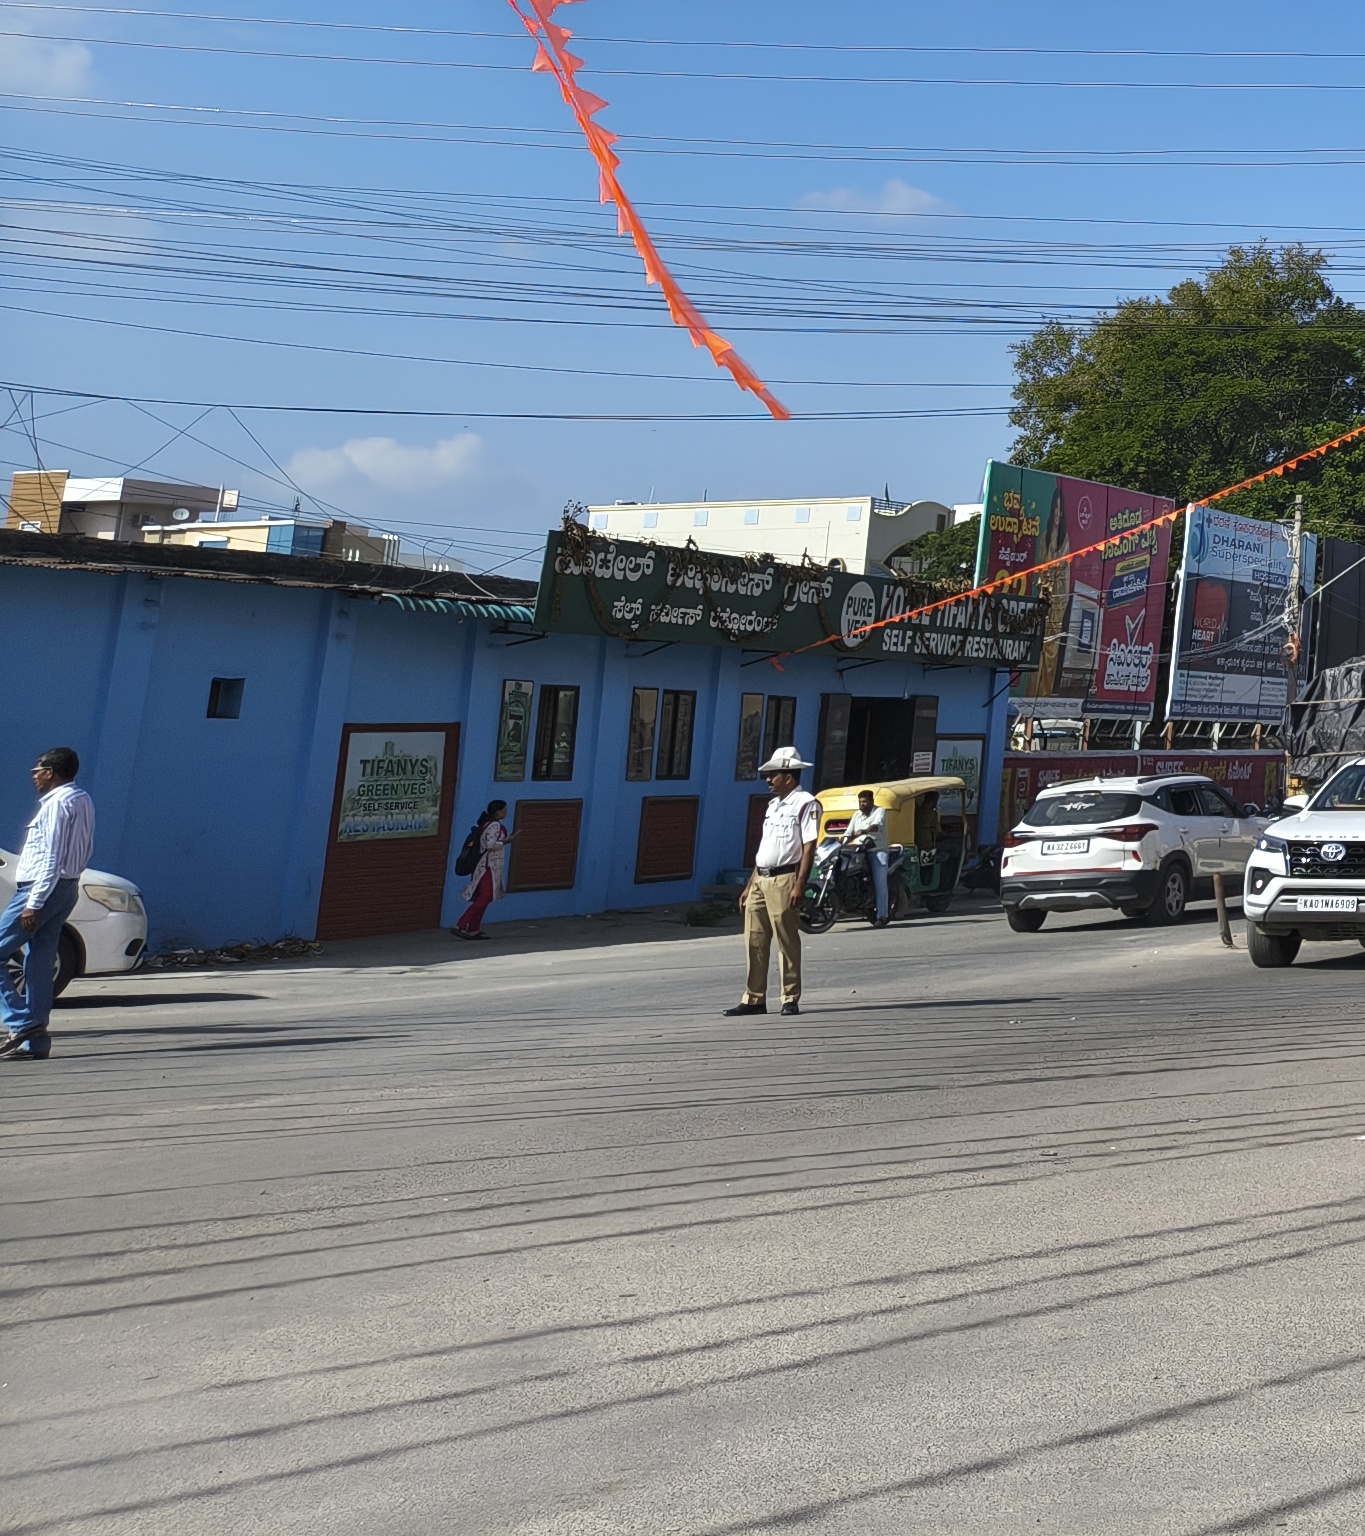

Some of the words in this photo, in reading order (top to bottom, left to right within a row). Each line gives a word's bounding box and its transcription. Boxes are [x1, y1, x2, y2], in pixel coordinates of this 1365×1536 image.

[1213, 533, 1264, 554] DHARANI
[1211, 546, 1288, 573] Superspeciality
[1253, 571, 1286, 584] HOSPITAL
[847, 597, 874, 613] PURE
[882, 629, 913, 652] SELF
[914, 632, 962, 656] SERVICE
[1192, 629, 1216, 642] HEART
[360, 758, 429, 777] TIFANYS
[357, 784, 398, 797] GREEN
[404, 783, 426, 795] VEG
[362, 803, 381, 812] SELF
[384, 801, 418, 810] SERVICE
